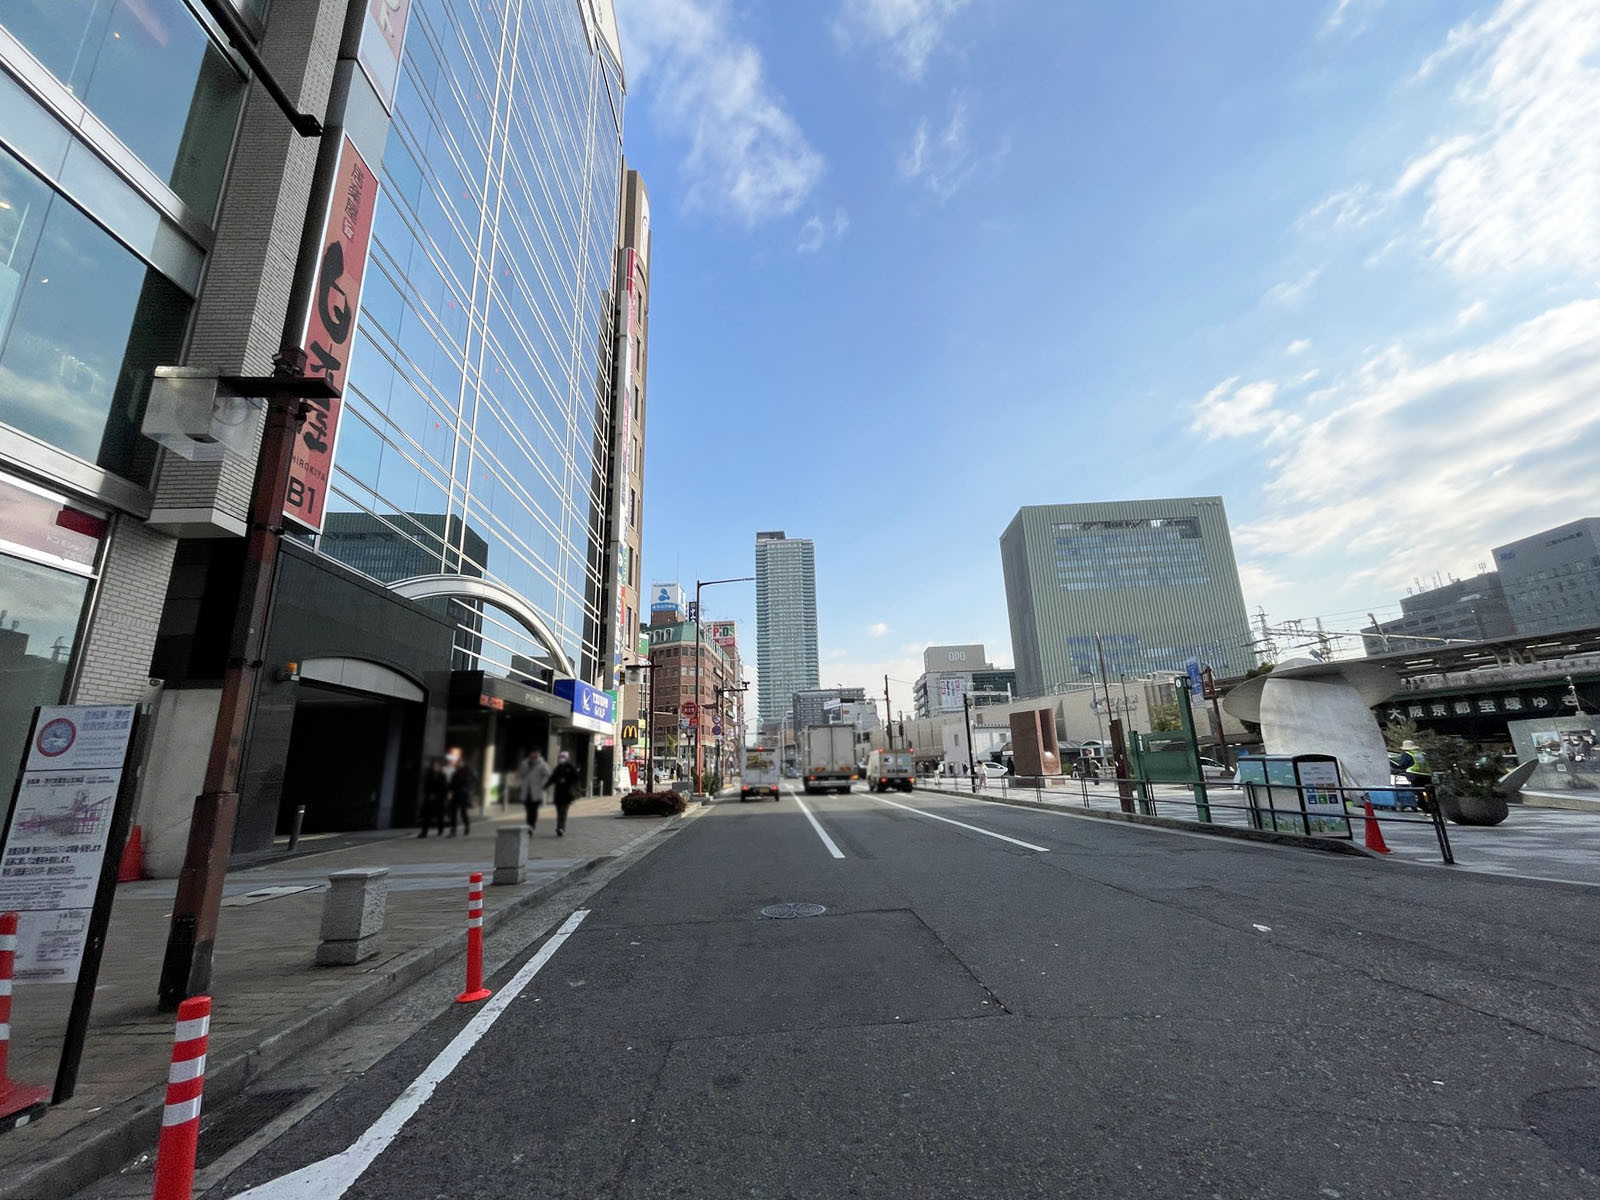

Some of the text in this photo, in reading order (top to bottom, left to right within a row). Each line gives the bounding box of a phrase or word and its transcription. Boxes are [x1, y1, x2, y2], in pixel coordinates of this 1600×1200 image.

[291, 455, 326, 481] HIROKIYA
[287, 476, 316, 514] B1
[1387, 694, 1580, 720] 大阪京都宝塚ゆき
